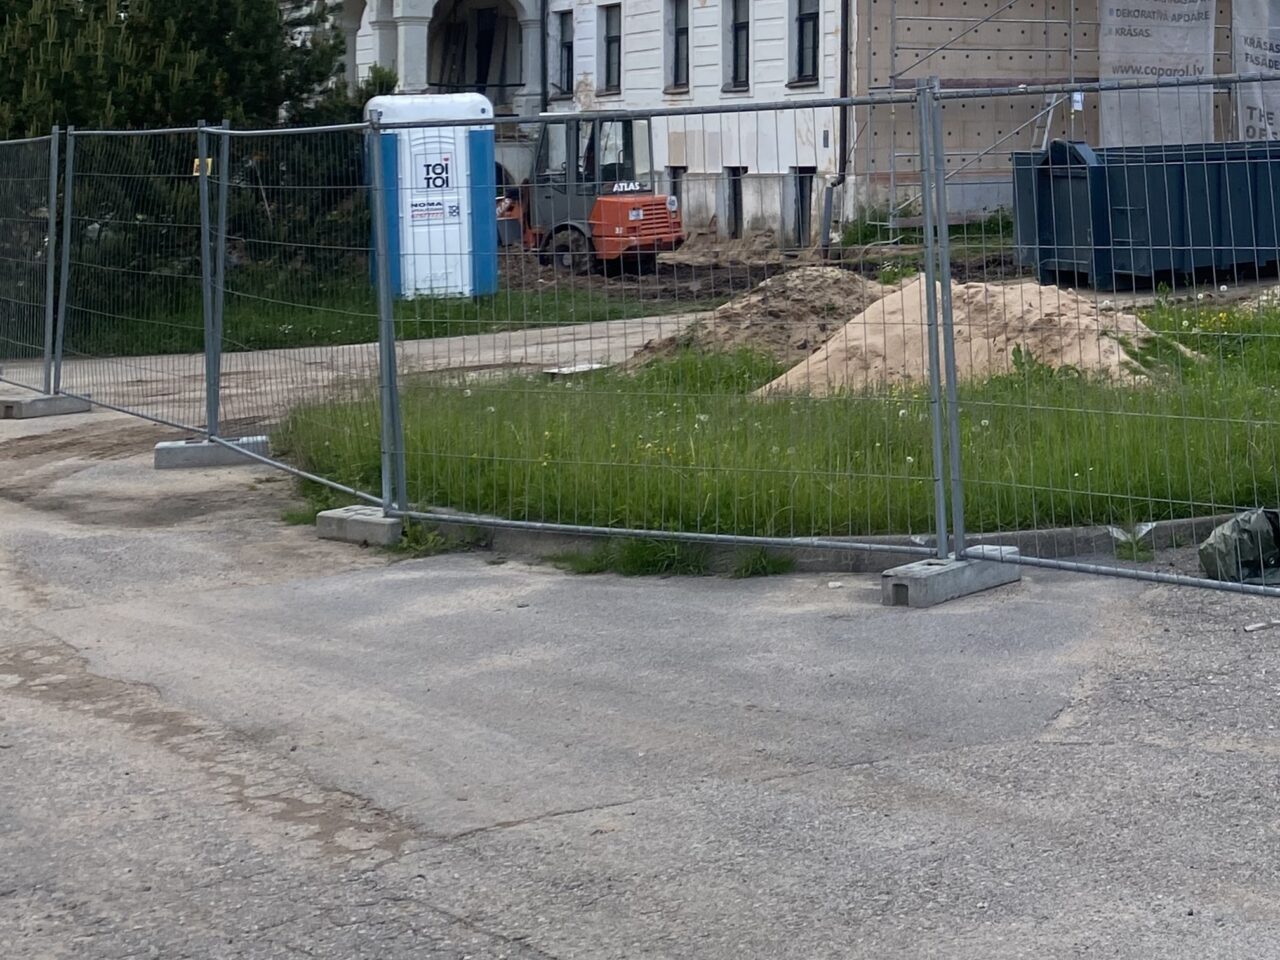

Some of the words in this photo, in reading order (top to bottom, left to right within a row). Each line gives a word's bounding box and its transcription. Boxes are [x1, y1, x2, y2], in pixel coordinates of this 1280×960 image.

[1246, 106, 1275, 126] THE
[424, 162, 449, 176] TOI
[424, 176, 449, 188] TOI
[613, 182, 640, 192] ATLAS
